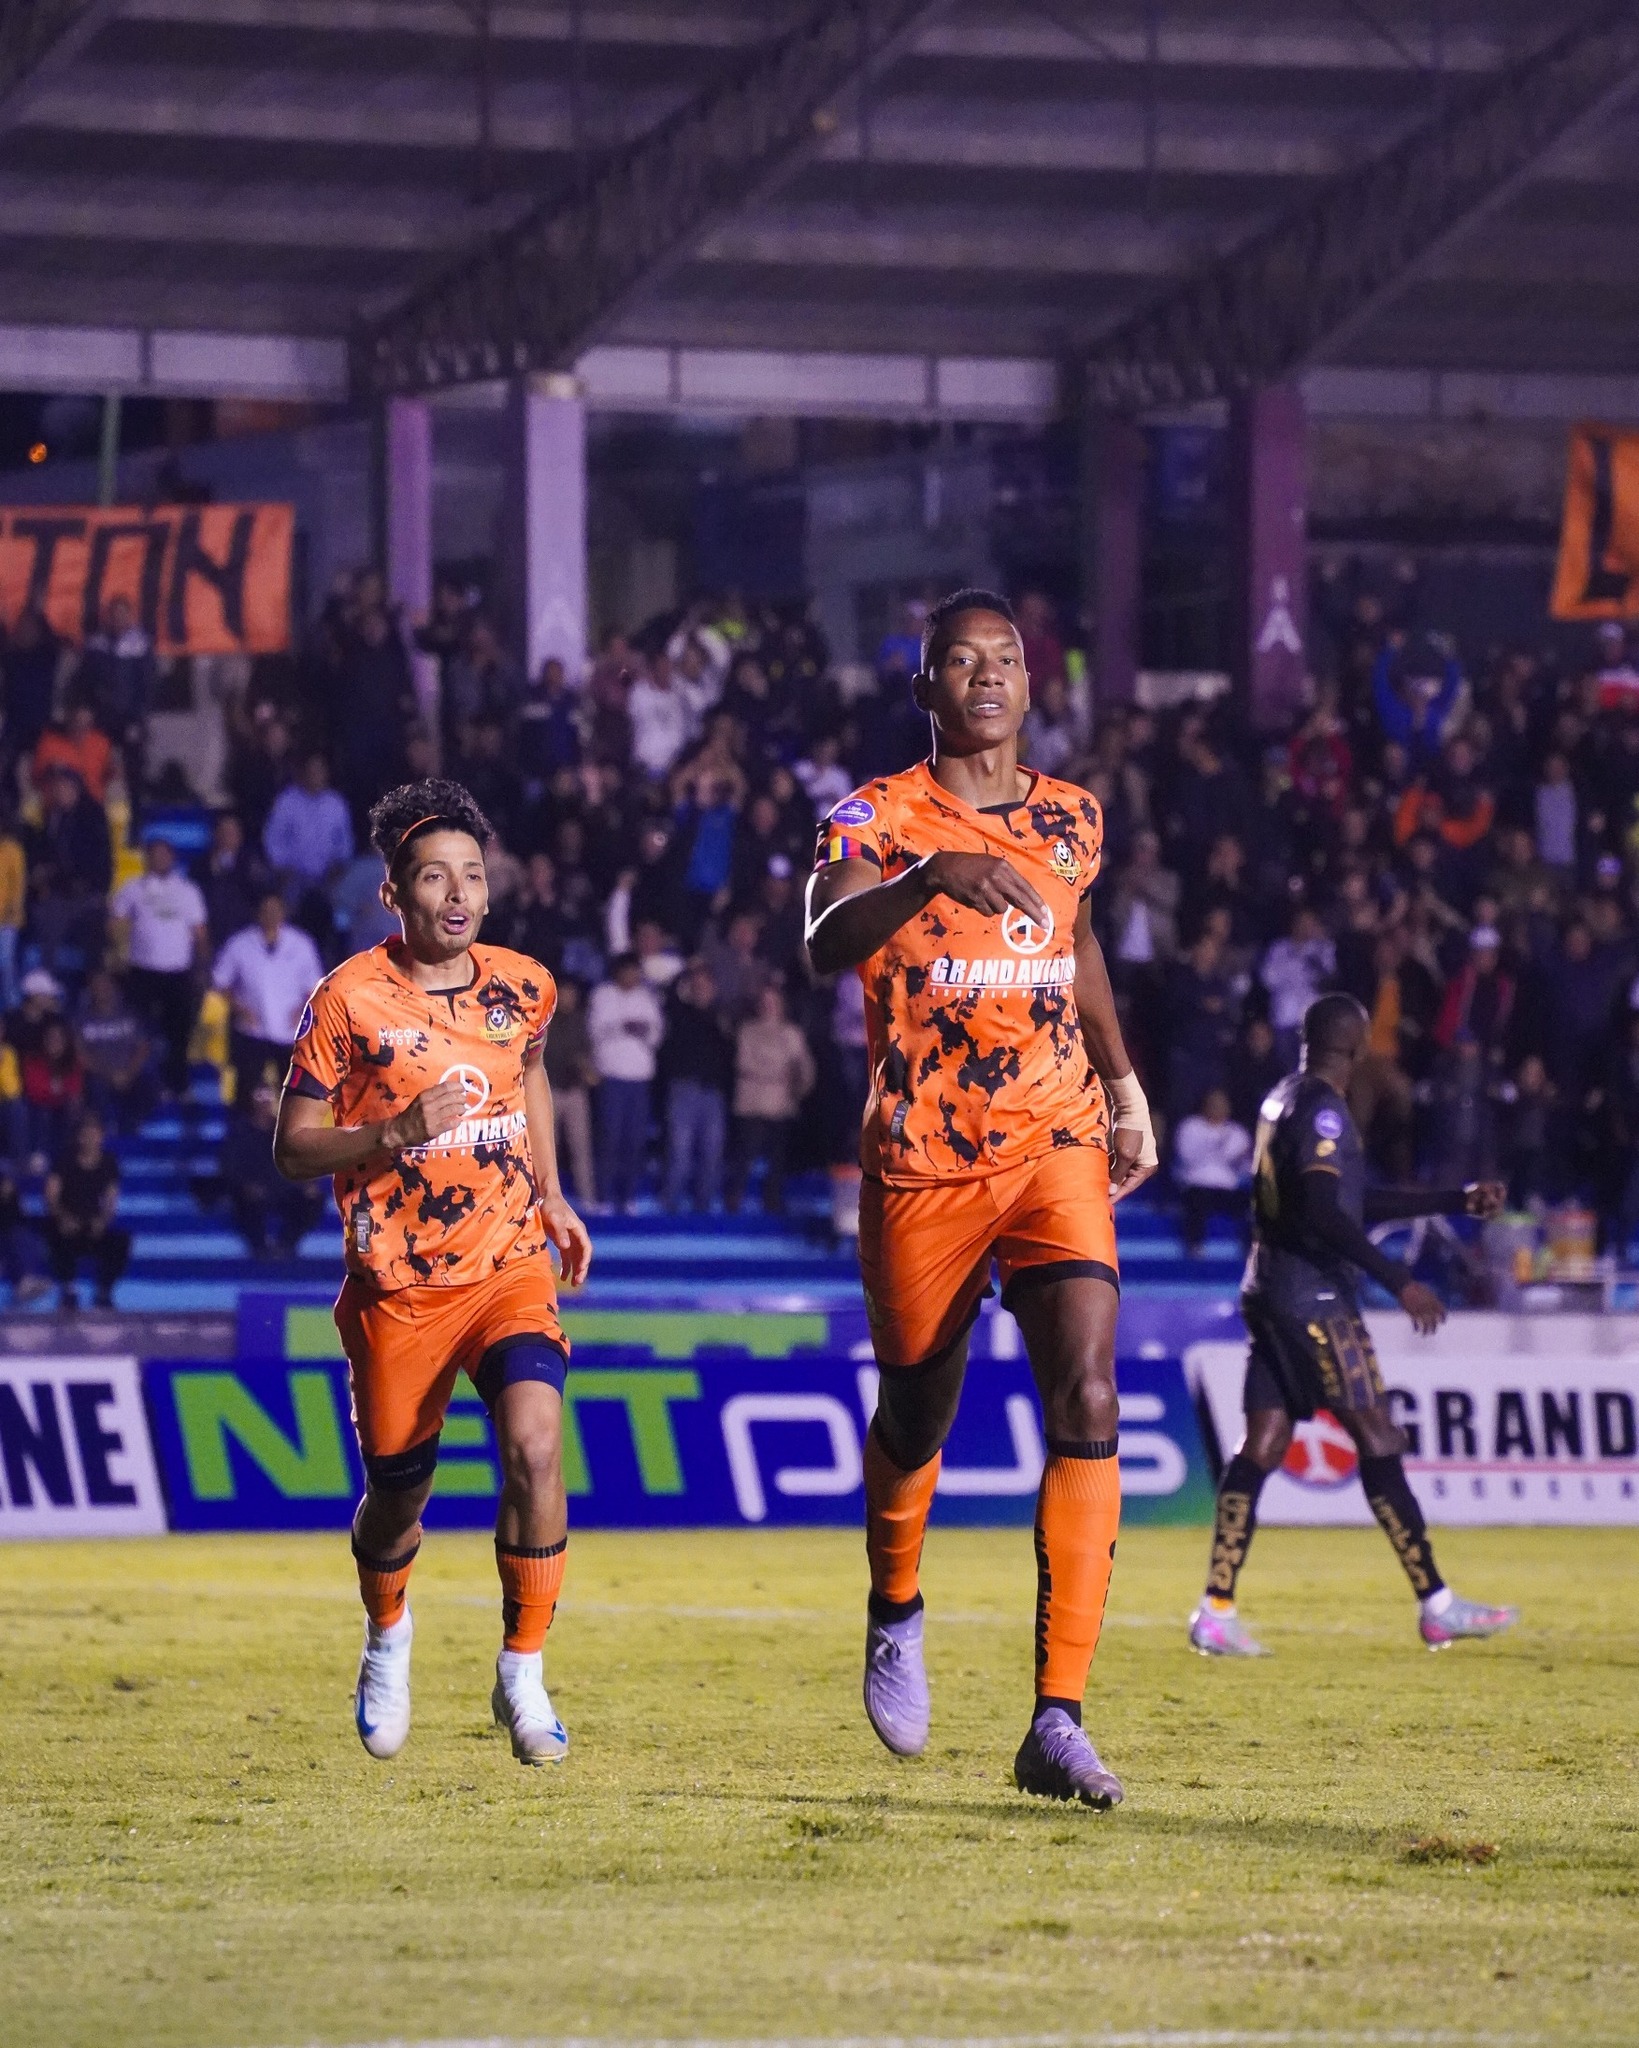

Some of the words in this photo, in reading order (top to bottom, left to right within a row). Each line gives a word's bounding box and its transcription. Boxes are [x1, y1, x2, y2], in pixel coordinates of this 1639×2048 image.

[931, 957, 1015, 984] GRAND
[0, 1384, 138, 1506] NE
[1383, 1388, 1638, 1458] GRAND
